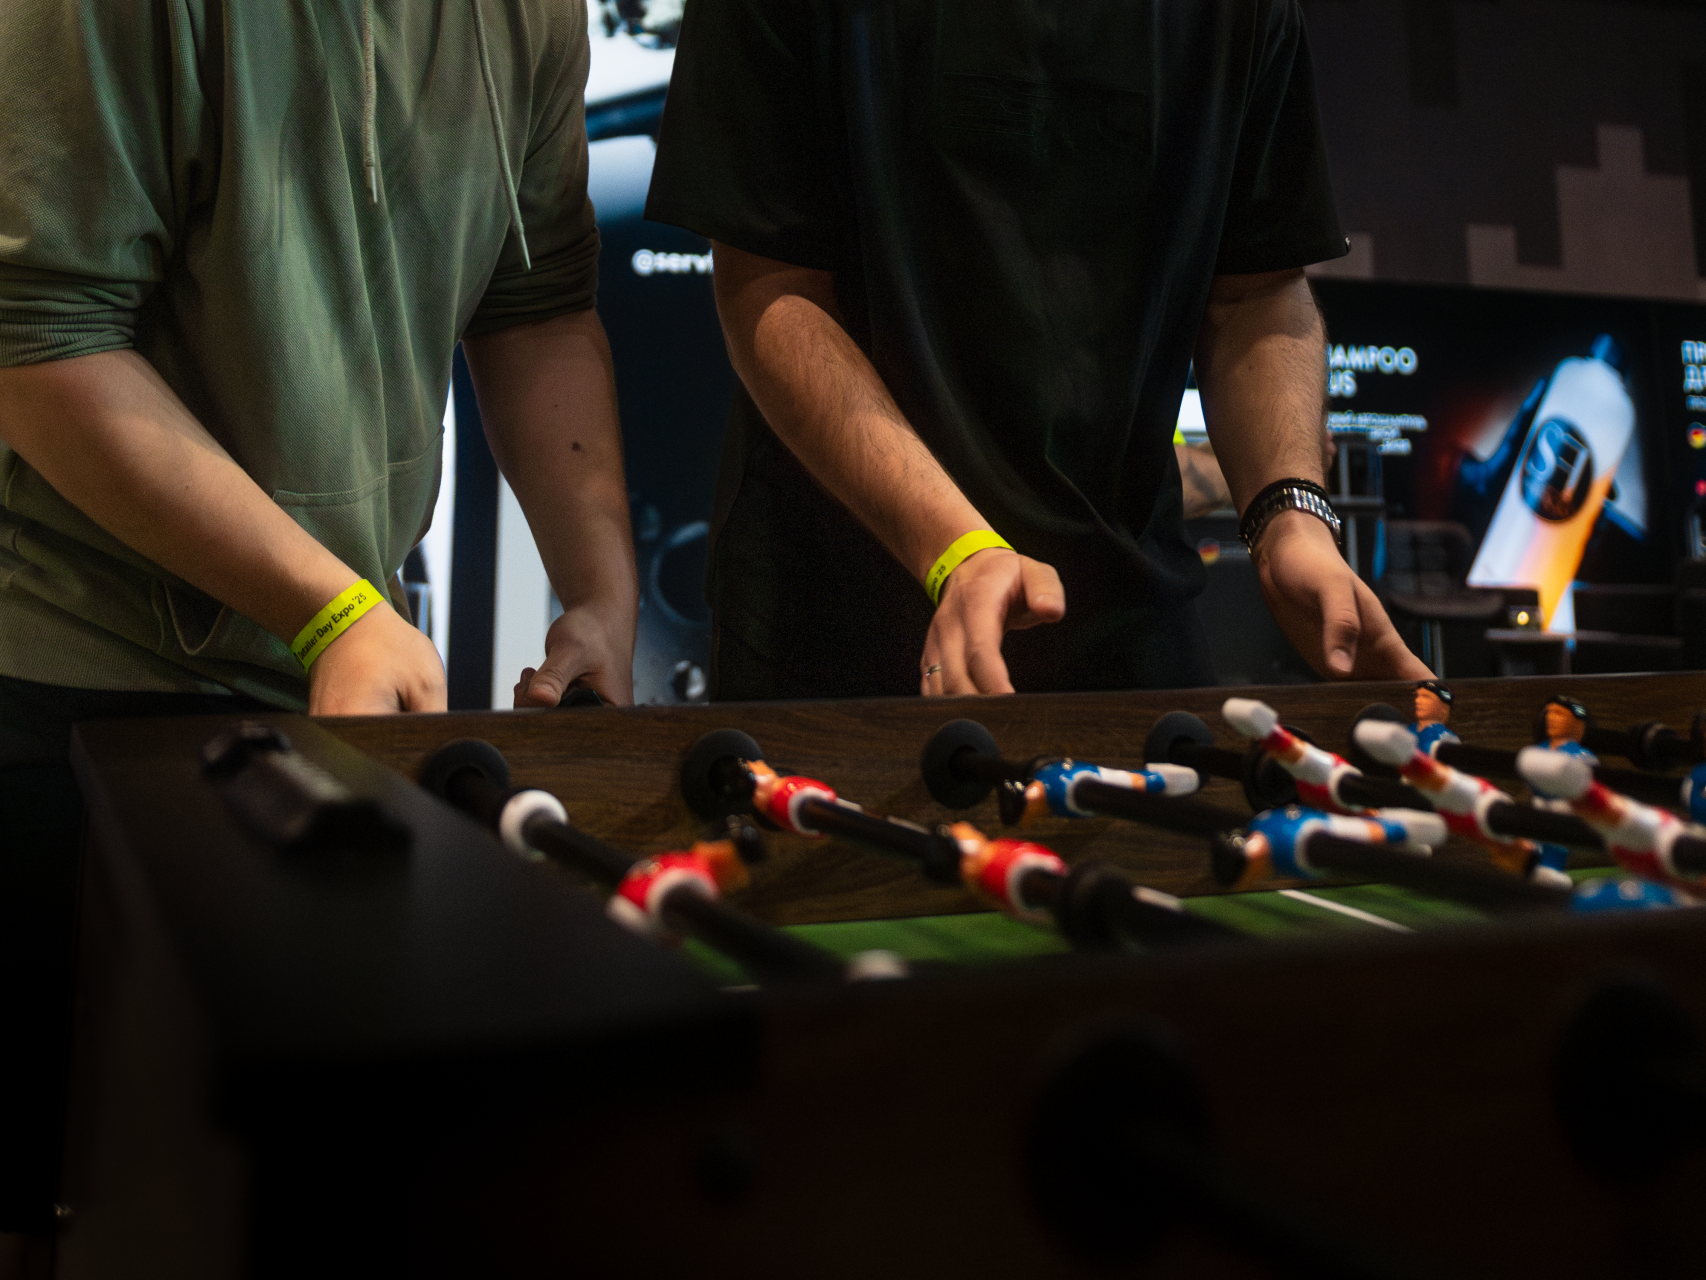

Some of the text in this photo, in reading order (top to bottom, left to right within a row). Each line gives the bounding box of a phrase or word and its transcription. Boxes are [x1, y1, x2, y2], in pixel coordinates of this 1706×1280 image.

[316, 621, 333, 638] Day
[331, 603, 355, 624] Expo
[351, 592, 367, 605] '25
